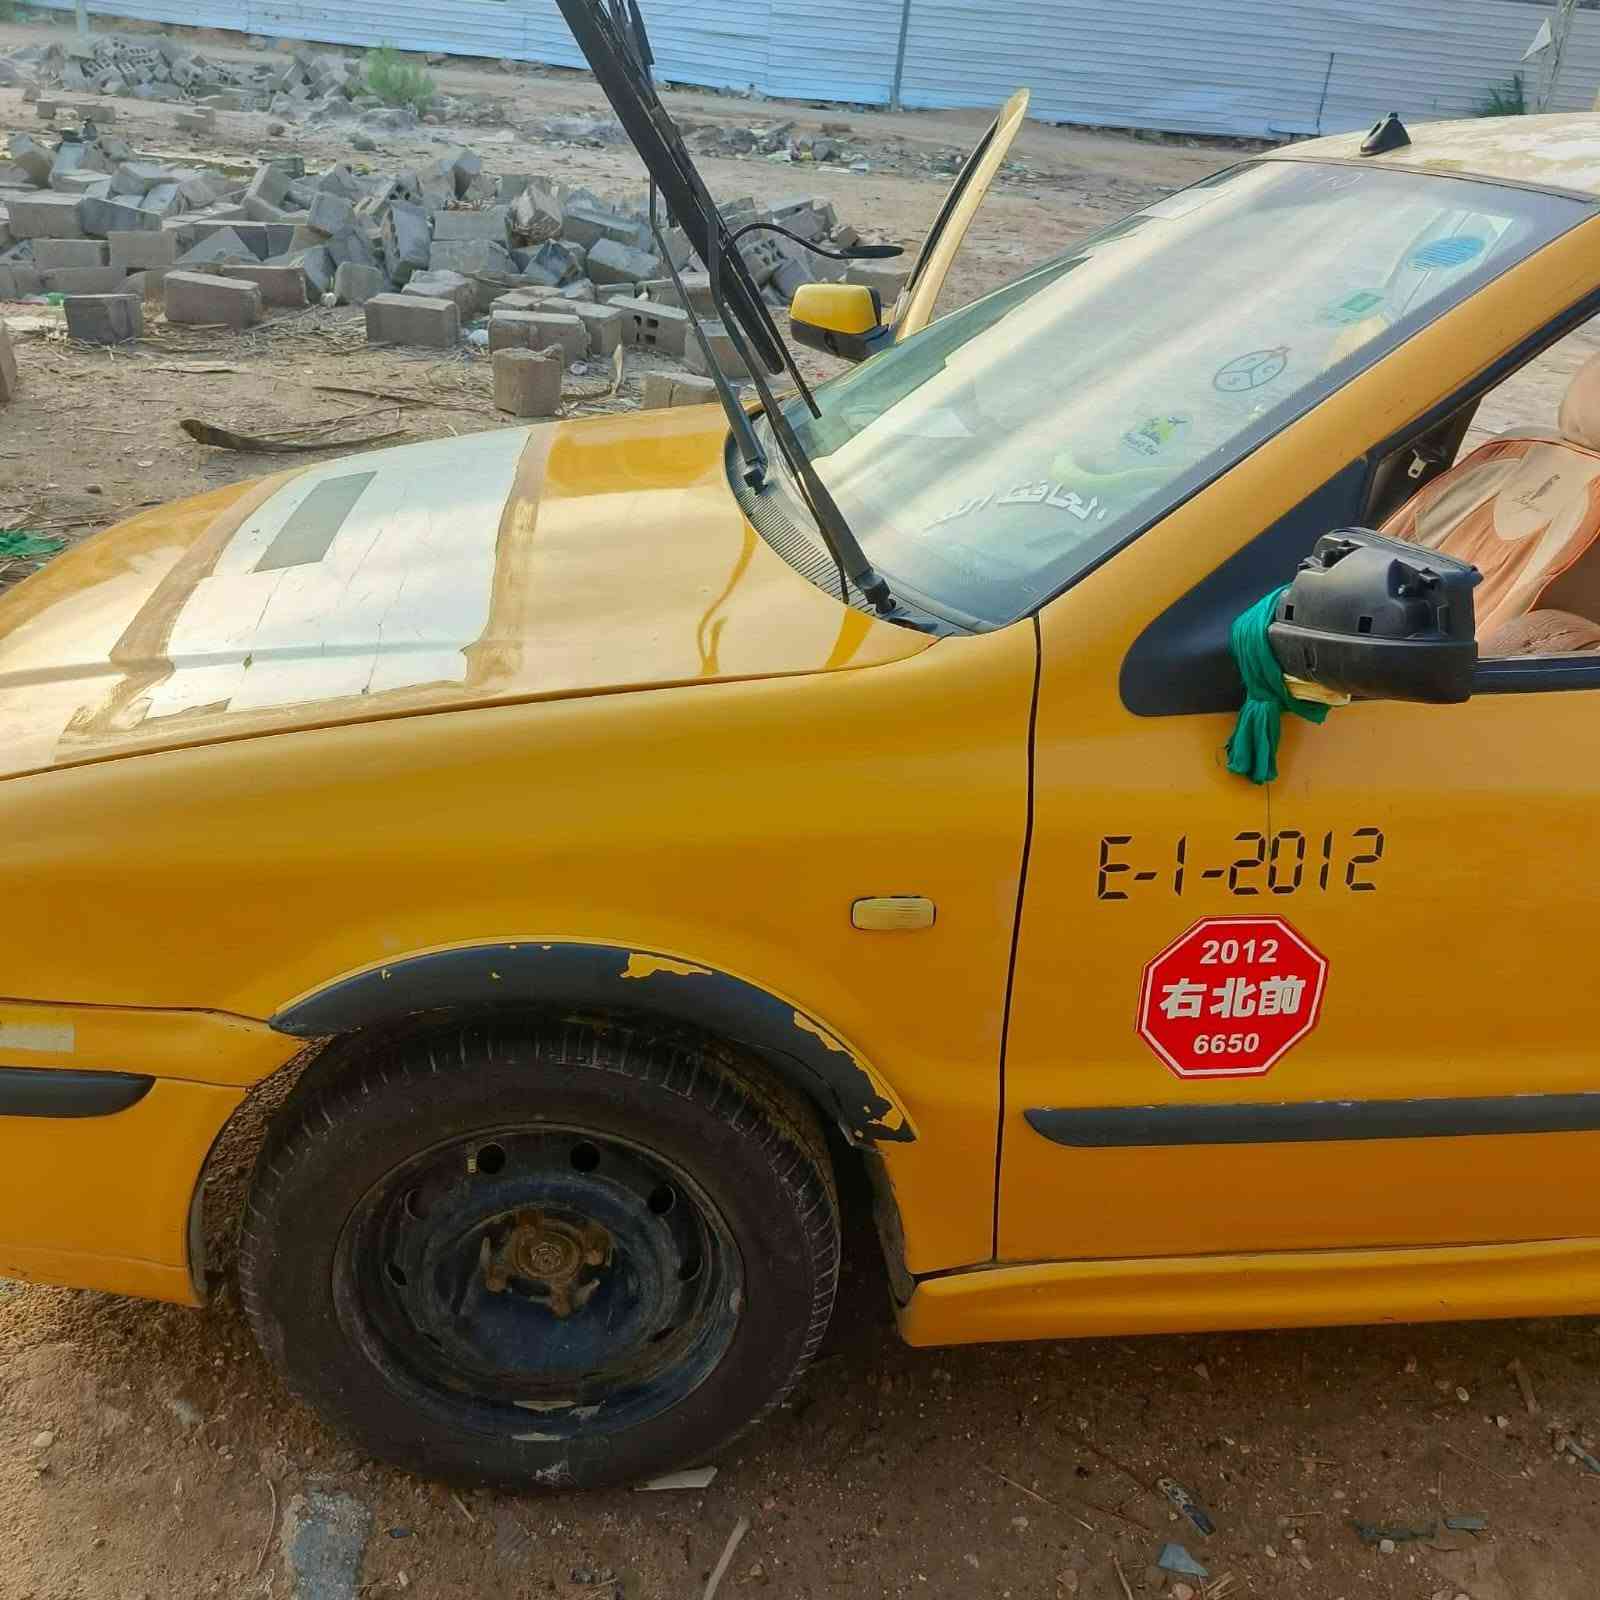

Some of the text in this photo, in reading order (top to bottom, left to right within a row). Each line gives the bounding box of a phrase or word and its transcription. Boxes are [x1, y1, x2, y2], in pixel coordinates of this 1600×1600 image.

[1097, 827, 1384, 900] E-1-2012
[1200, 939, 1279, 964] 2012
[1159, 975, 1306, 1020] 右北前
[1193, 1033, 1260, 1055] 6650
